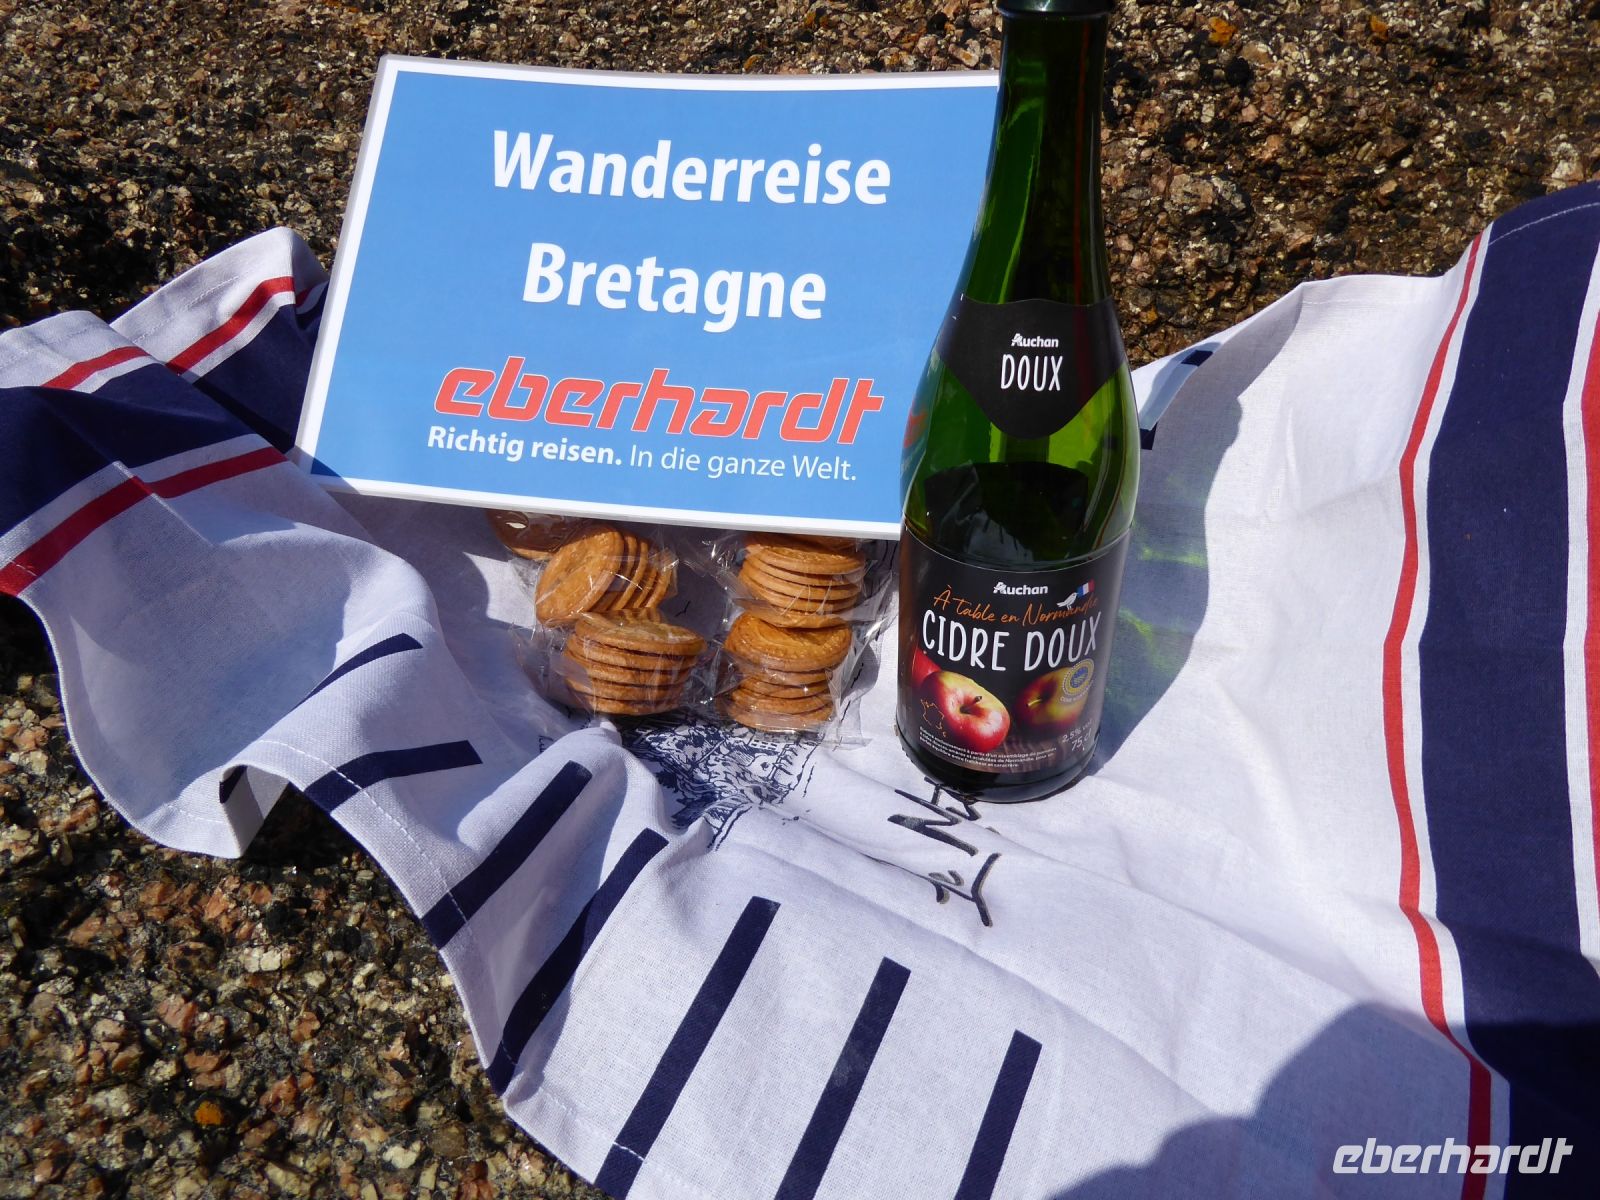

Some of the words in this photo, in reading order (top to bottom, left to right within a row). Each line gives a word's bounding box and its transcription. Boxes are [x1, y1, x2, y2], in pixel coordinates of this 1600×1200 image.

[492, 129, 892, 206] Wanderreise
[522, 242, 827, 334] Bretagne
[1011, 332, 1059, 348] Auchan
[433, 355, 885, 445] eberhardt
[1000, 353, 1064, 392] DOUX
[427, 425, 525, 463] Richtig
[530, 437, 622, 466] reisen.
[630, 444, 653, 468] In
[660, 446, 701, 472] die
[706, 454, 786, 479] ganze
[792, 455, 857, 481] Welt.
[951, 597, 996, 622] table
[1000, 615, 1020, 623] en
[993, 581, 1049, 596] Auchan
[922, 609, 1010, 672] CIDRE
[1023, 610, 1102, 672] DOUX
